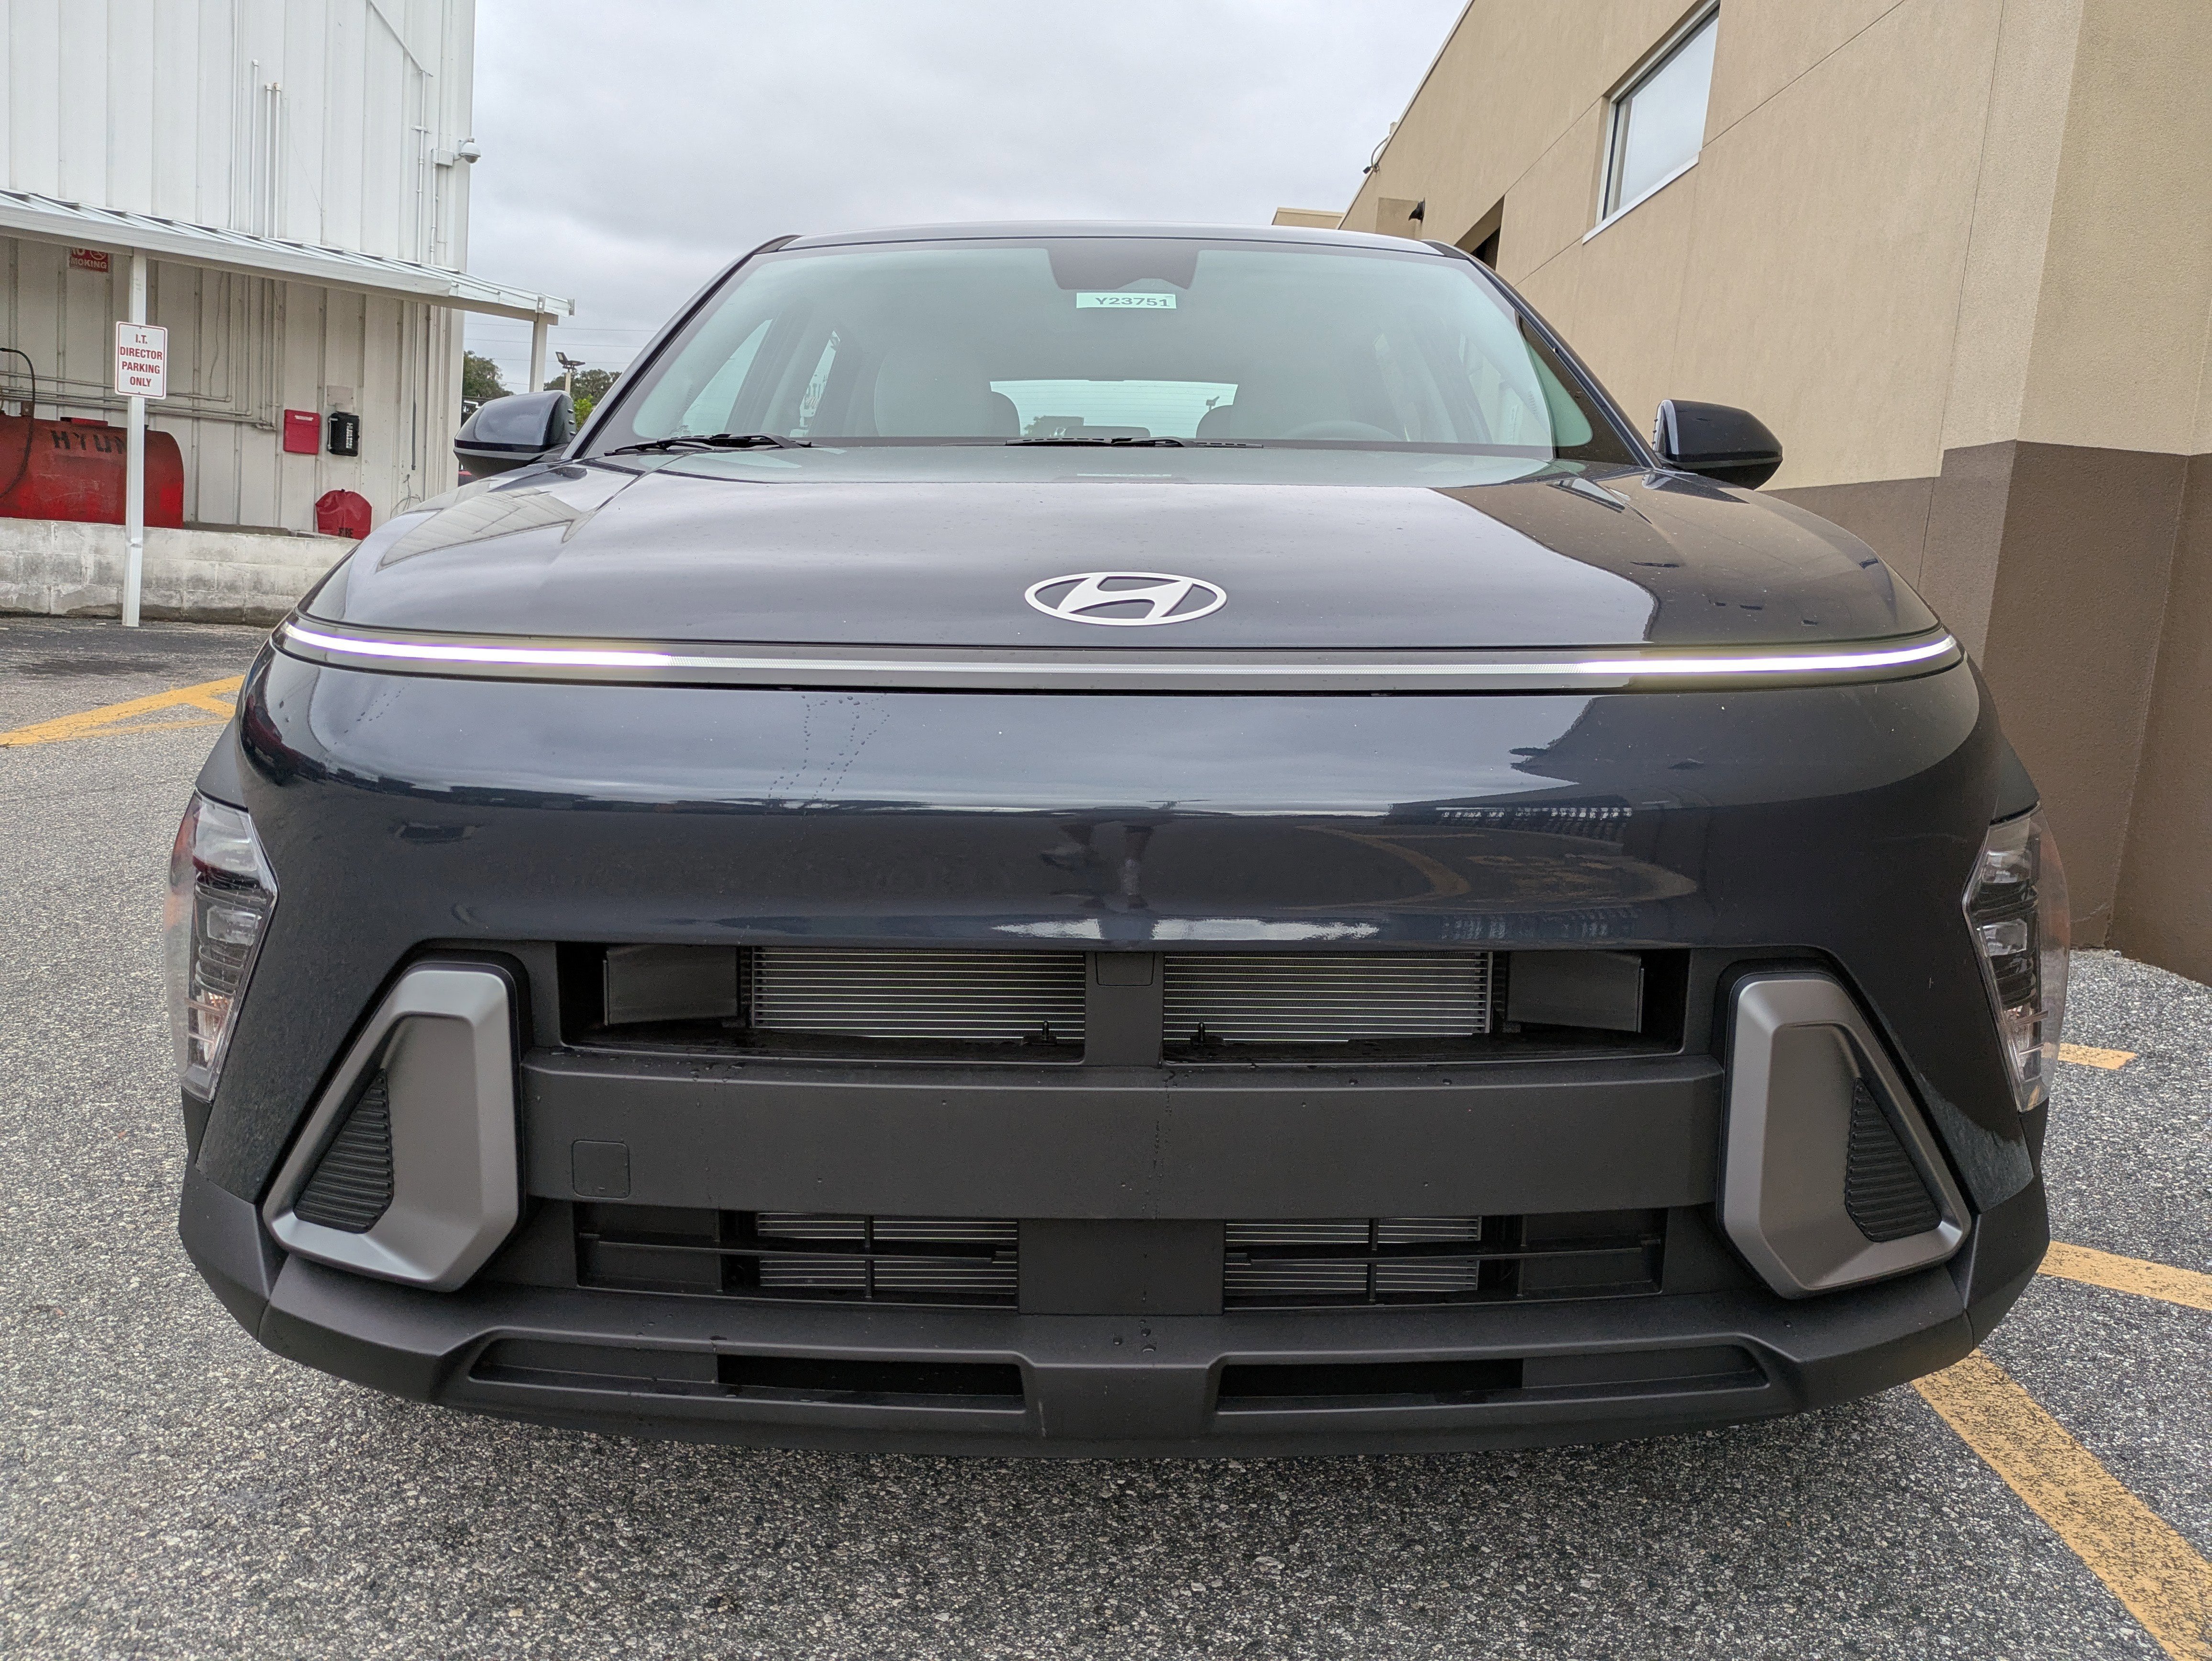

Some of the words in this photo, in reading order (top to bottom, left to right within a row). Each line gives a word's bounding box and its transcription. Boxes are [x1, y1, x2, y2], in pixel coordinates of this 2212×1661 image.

[71, 258, 107, 269] MOKING
[1095, 298, 1170, 307] Y23751
[135, 334, 148, 344] I.T.
[120, 346, 163, 360] DIRECTOR
[122, 361, 160, 374] PARKING
[130, 376, 152, 387] ONLY
